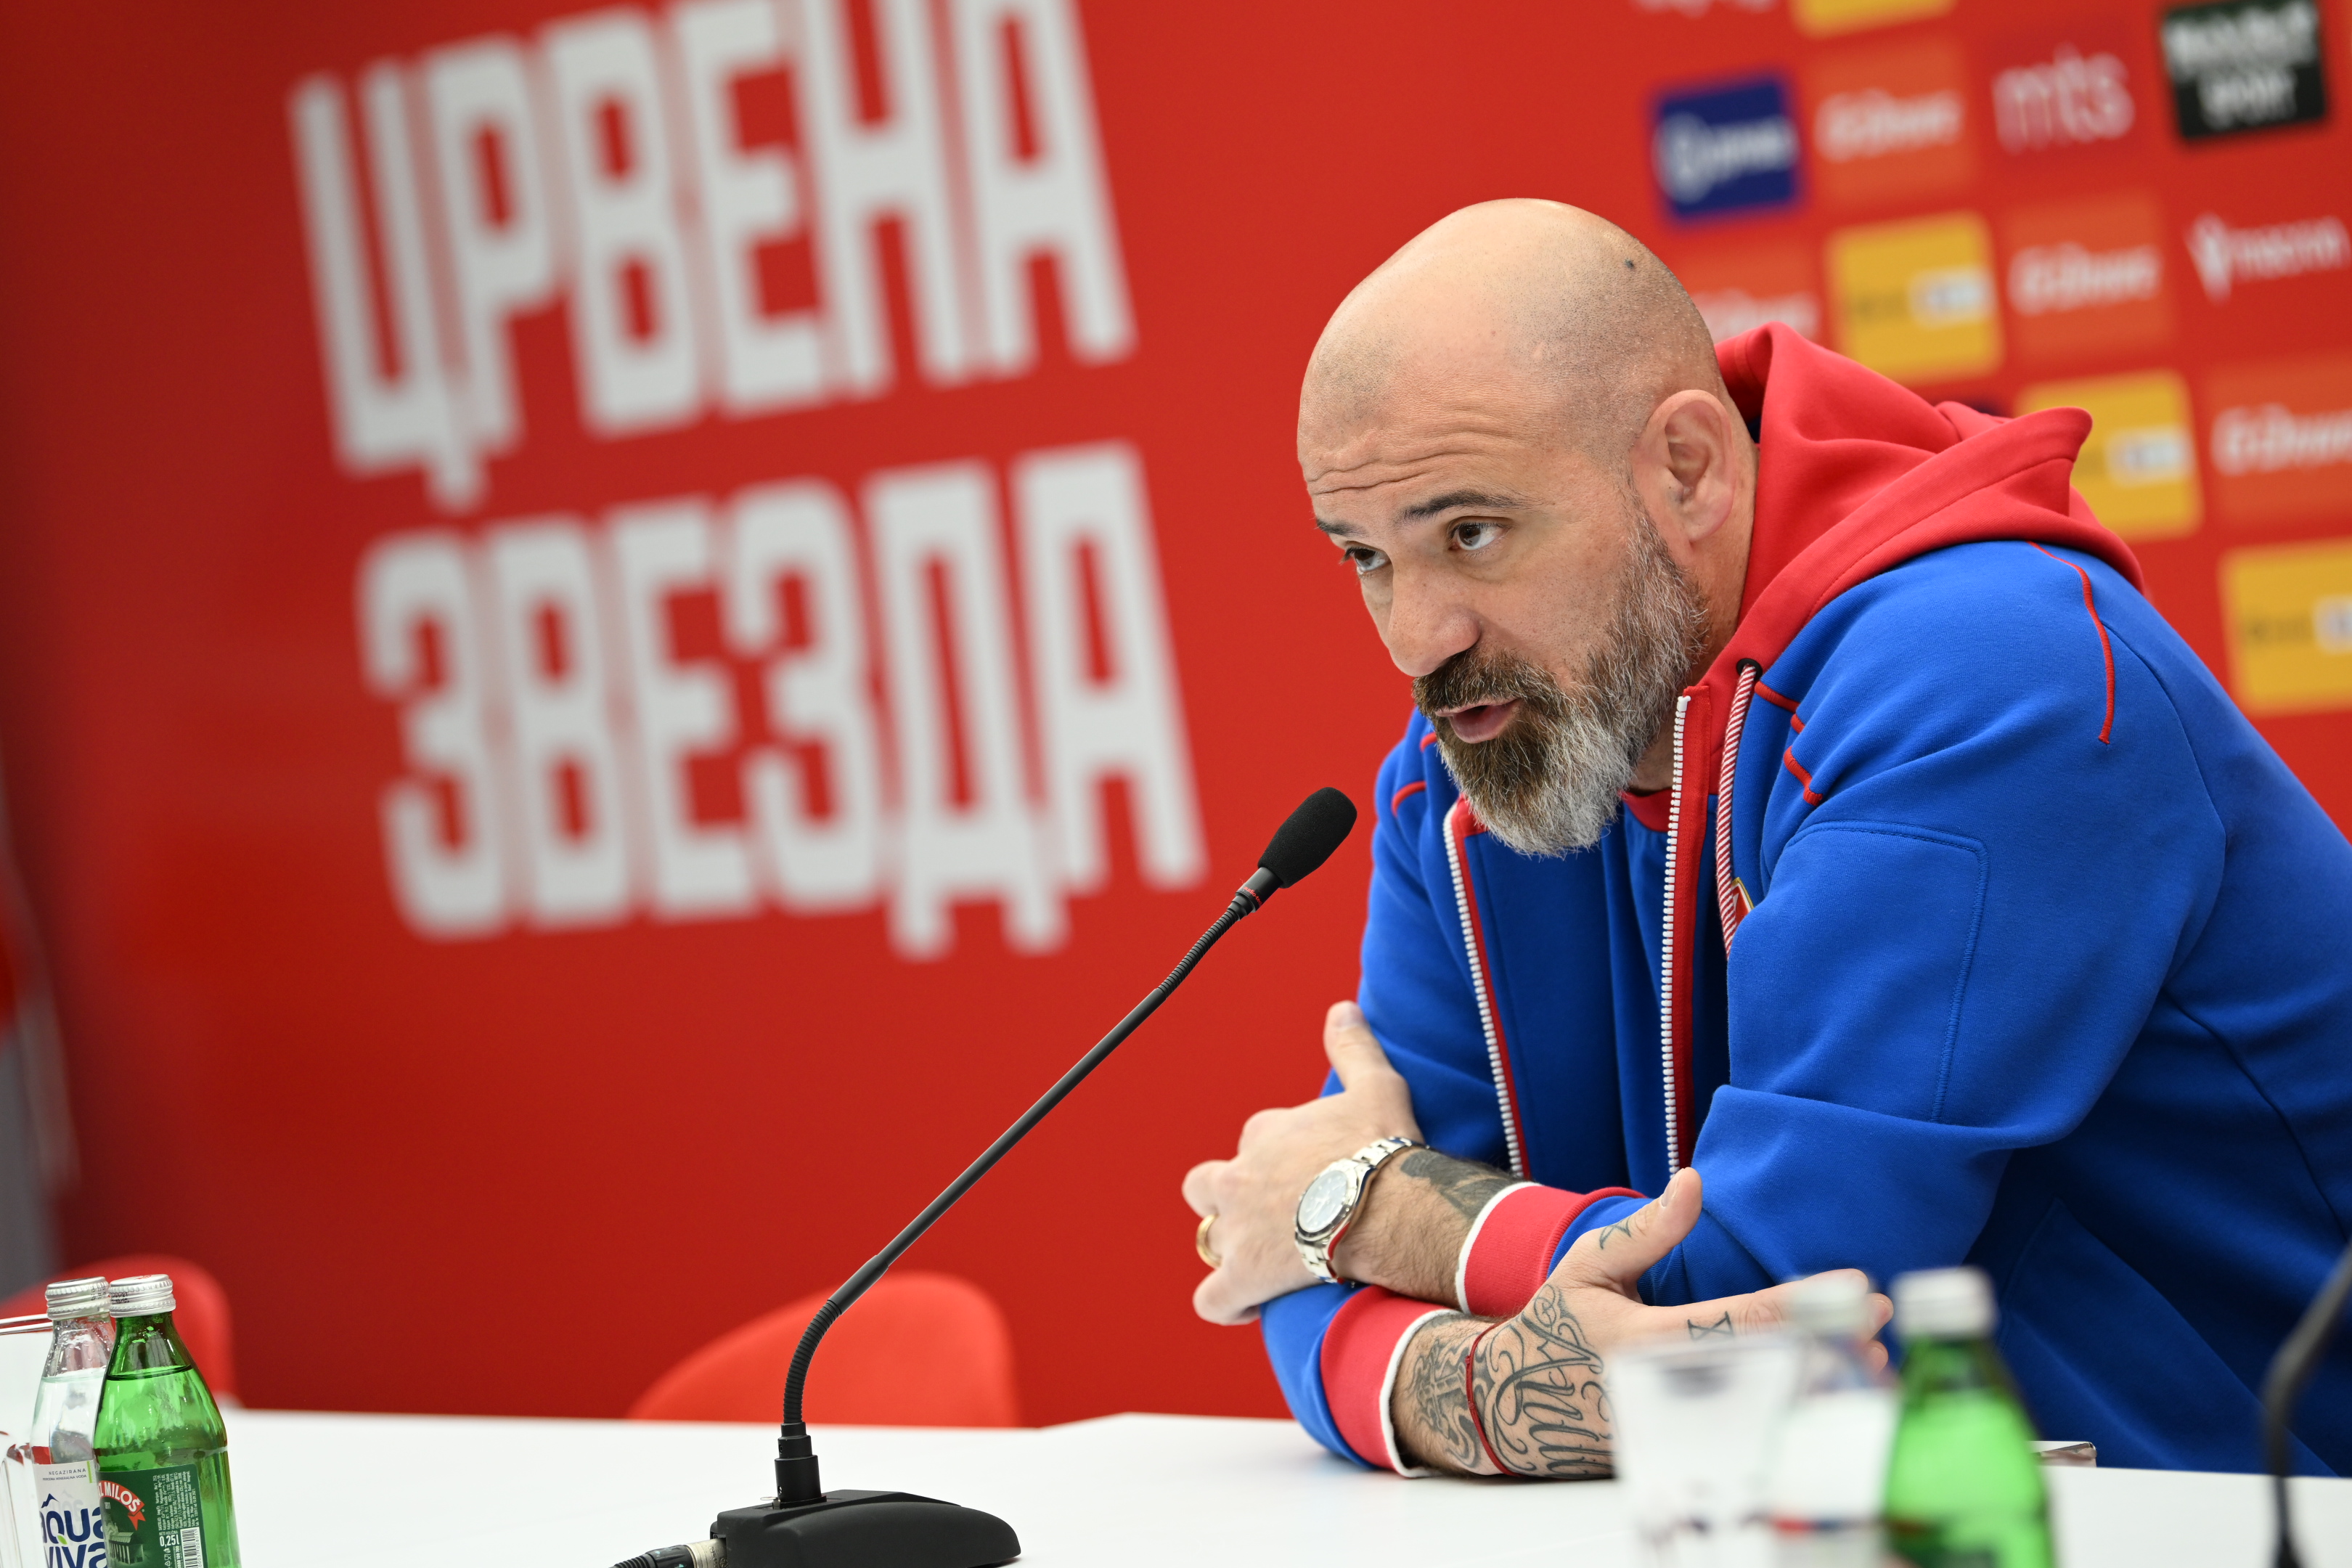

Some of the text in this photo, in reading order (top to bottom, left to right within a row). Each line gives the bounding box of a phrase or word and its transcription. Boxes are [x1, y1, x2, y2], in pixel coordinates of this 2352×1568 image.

[1993, 48, 2133, 151] mts
[290, 0, 1134, 511] ЦРВЕНА
[358, 438, 1204, 960] ЗВЕЗДА
[104, 1482, 142, 1512] MILOŠ
